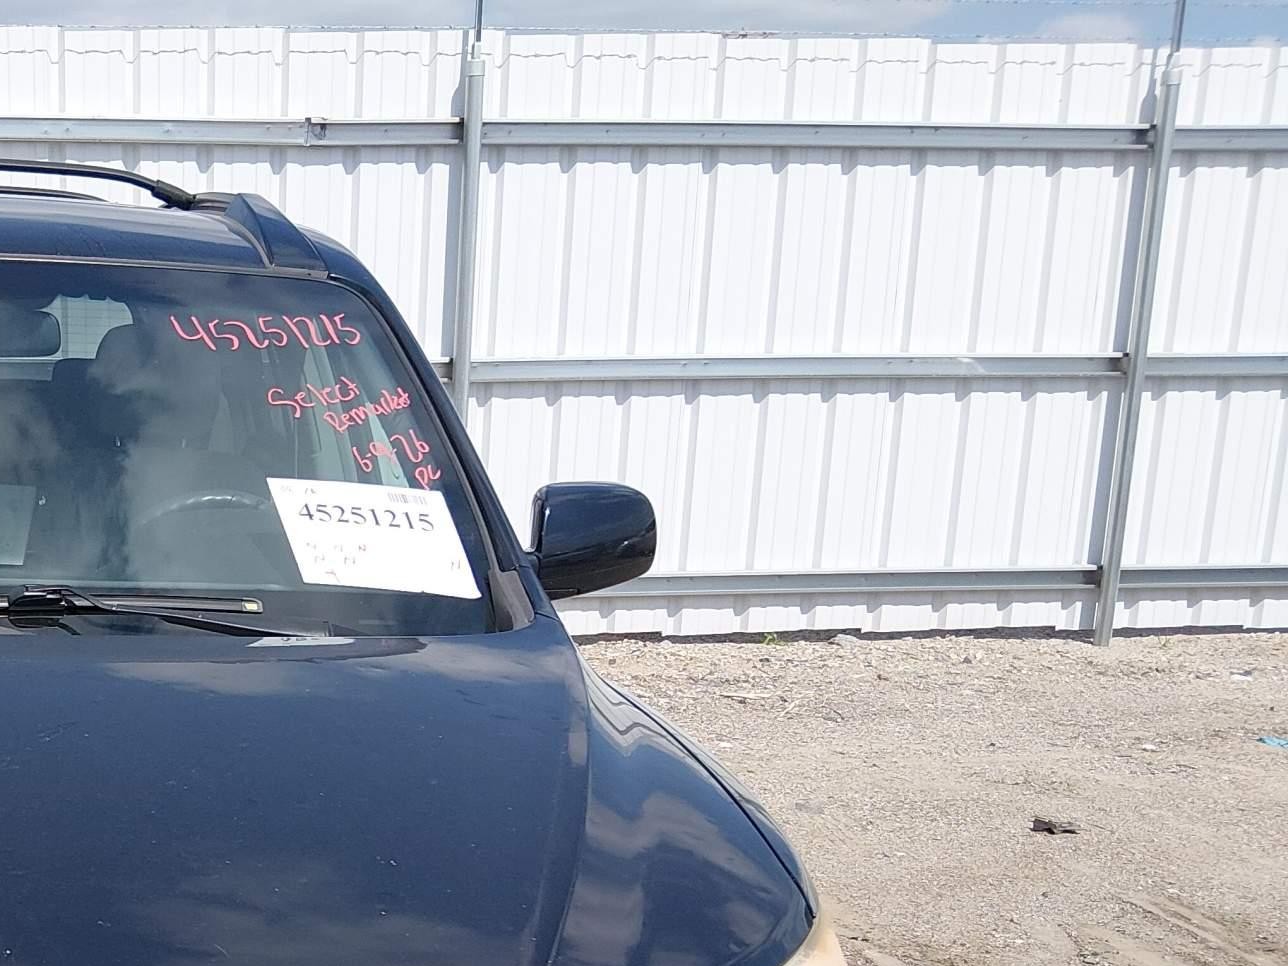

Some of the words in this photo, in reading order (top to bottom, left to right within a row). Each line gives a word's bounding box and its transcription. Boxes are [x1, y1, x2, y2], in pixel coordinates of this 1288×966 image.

[170, 313, 362, 351] 45251215
[267, 376, 360, 418] Select
[298, 503, 434, 532] 45251215
